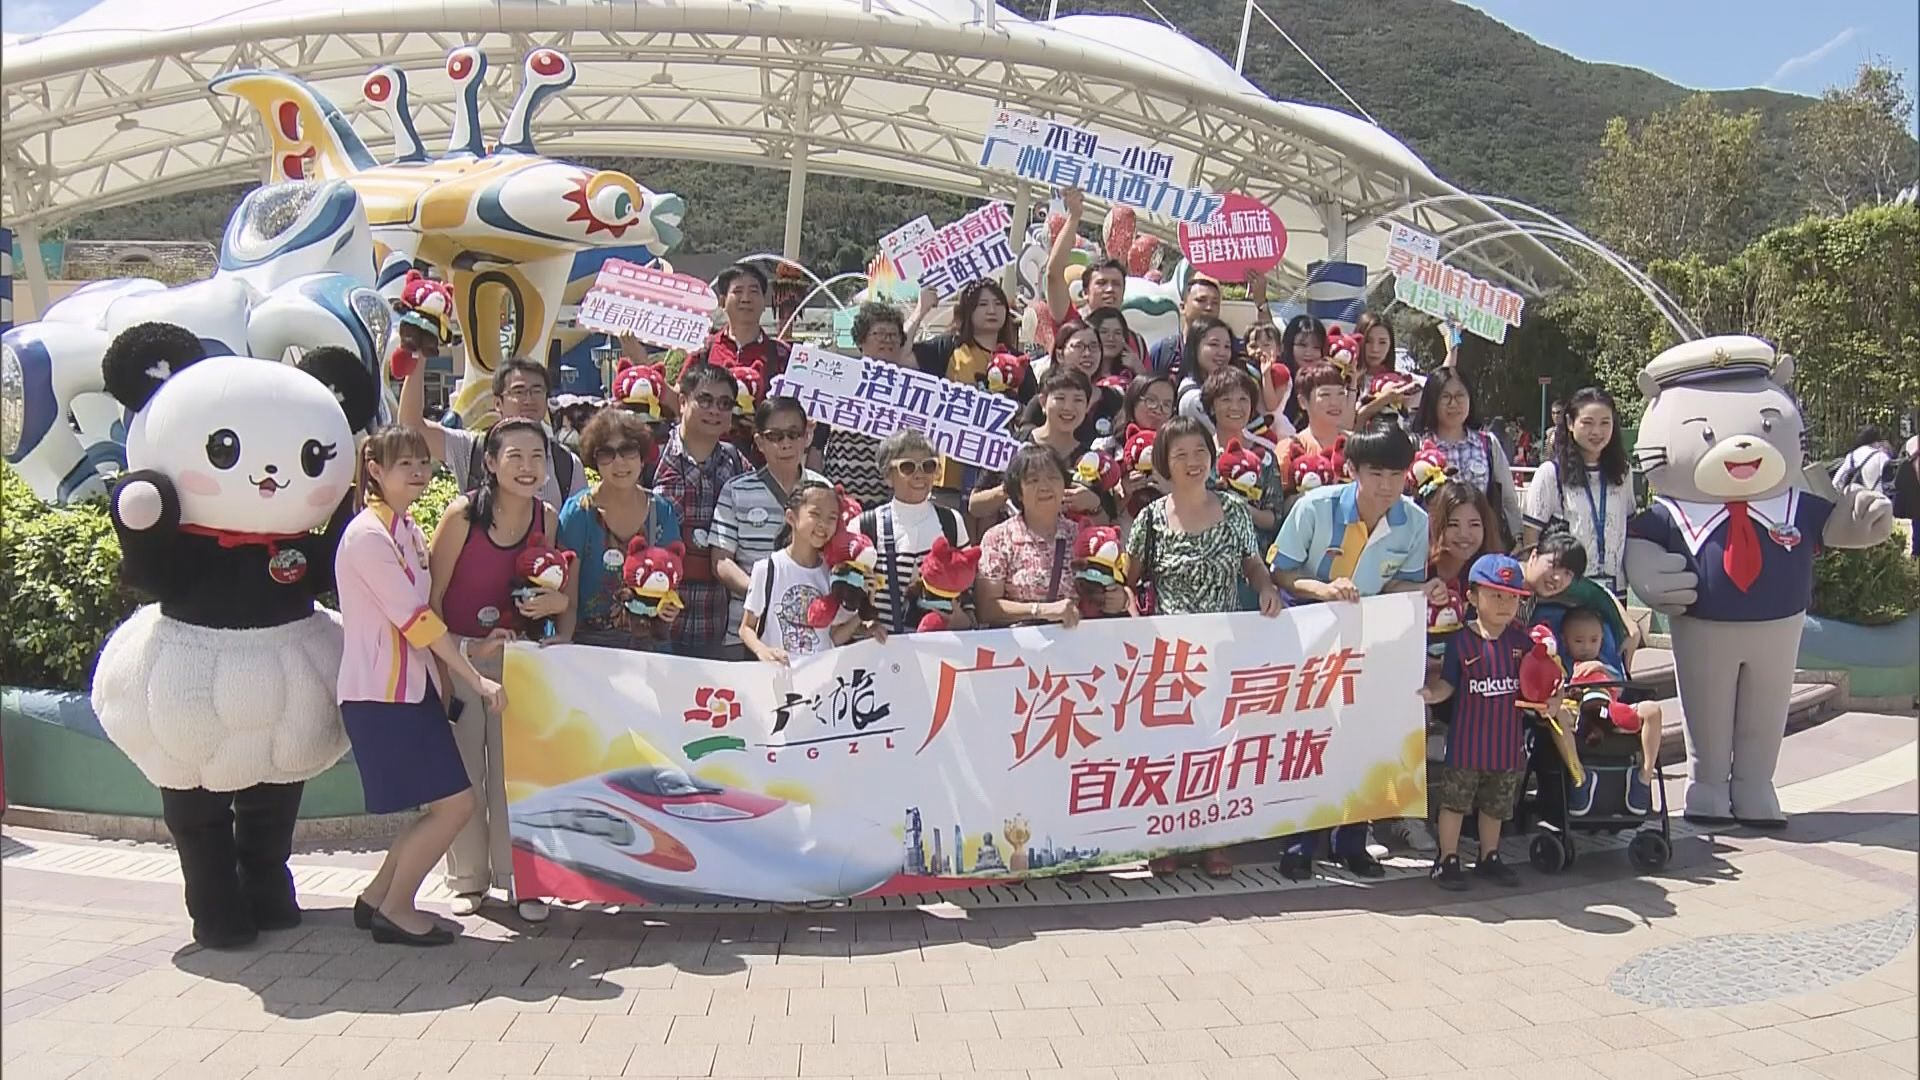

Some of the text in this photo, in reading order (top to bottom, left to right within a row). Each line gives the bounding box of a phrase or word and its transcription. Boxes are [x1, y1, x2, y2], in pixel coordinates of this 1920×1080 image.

[979, 136, 1223, 224] 广州直抵西九龙
[1045, 122, 1174, 179] 不到一小时
[893, 203, 1011, 281] 广深港高铁
[916, 231, 1016, 301] 尝鲜玩
[854, 360, 1015, 437] 港玩港吃
[914, 636, 1366, 772] 广深港 高铁
[1469, 676, 1520, 696] Rakute
[1069, 727, 1333, 816] 首发团开拔
[1146, 796, 1254, 836] 2018.9.23
